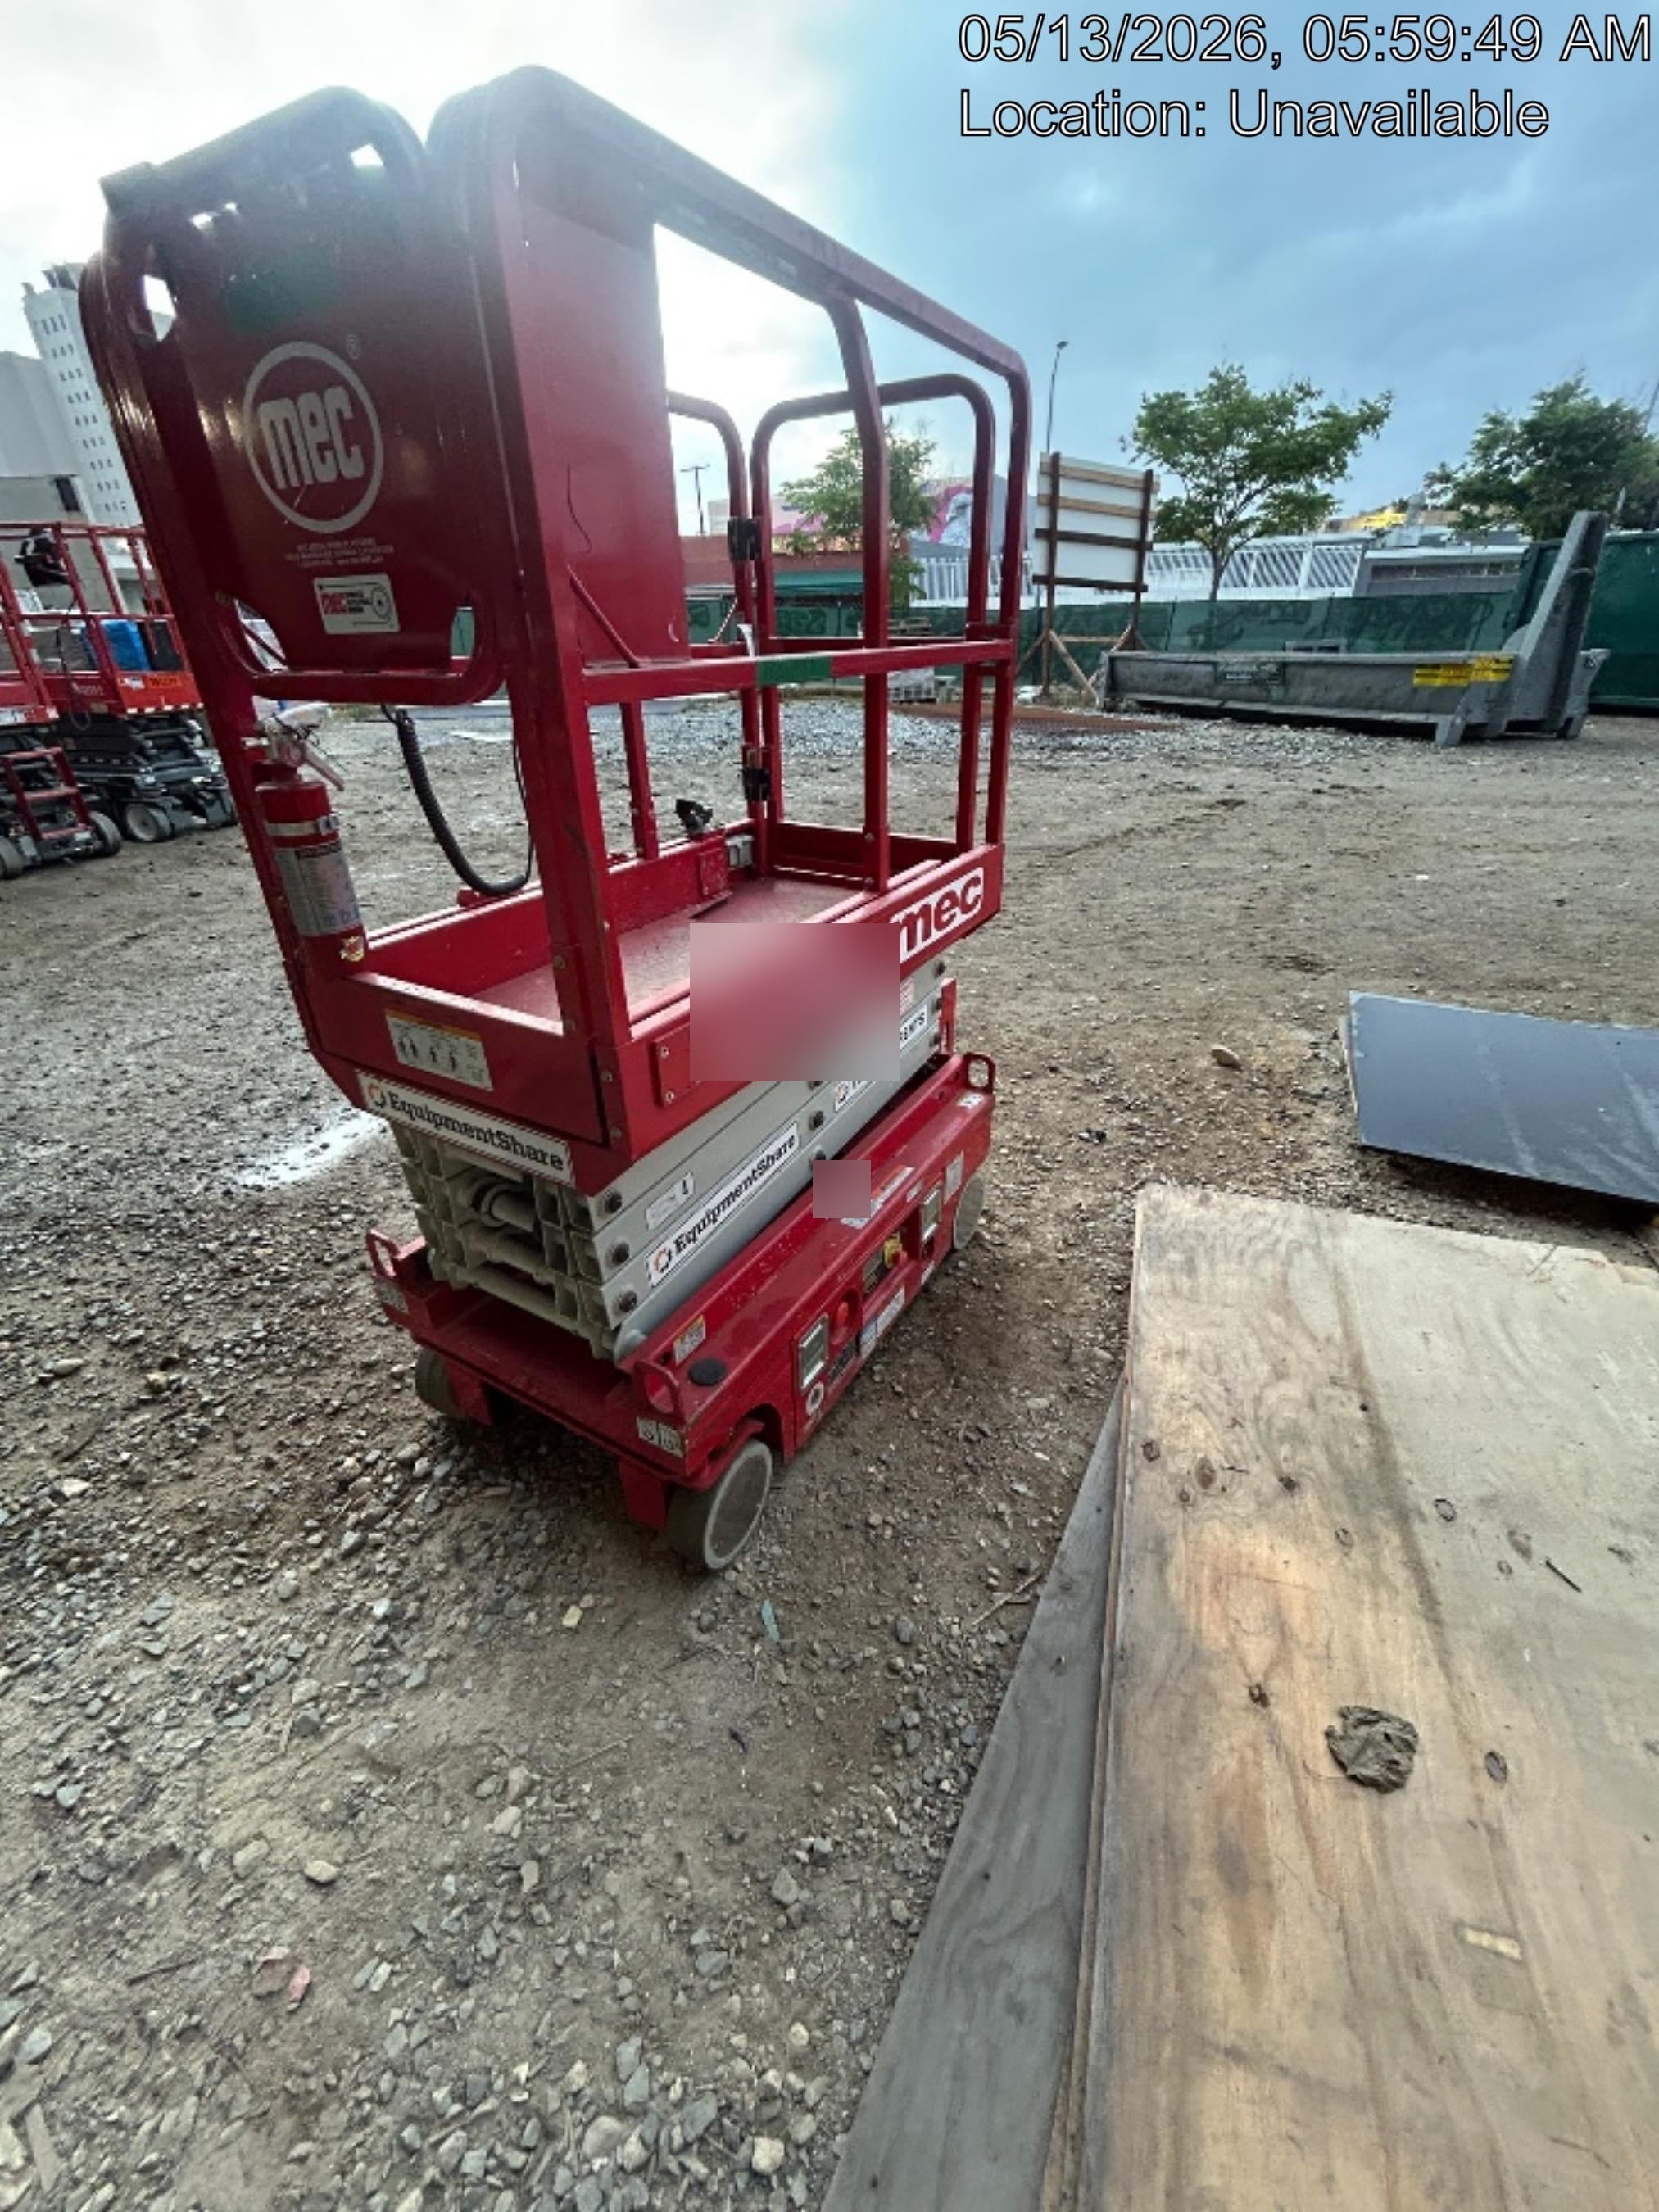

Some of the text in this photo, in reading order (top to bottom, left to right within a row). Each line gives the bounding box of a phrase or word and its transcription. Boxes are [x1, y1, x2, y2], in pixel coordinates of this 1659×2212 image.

[258, 385, 365, 491] mec
[388, 1091, 564, 1171] EquipmentShare
[673, 1134, 795, 1257] EquipmentShare
